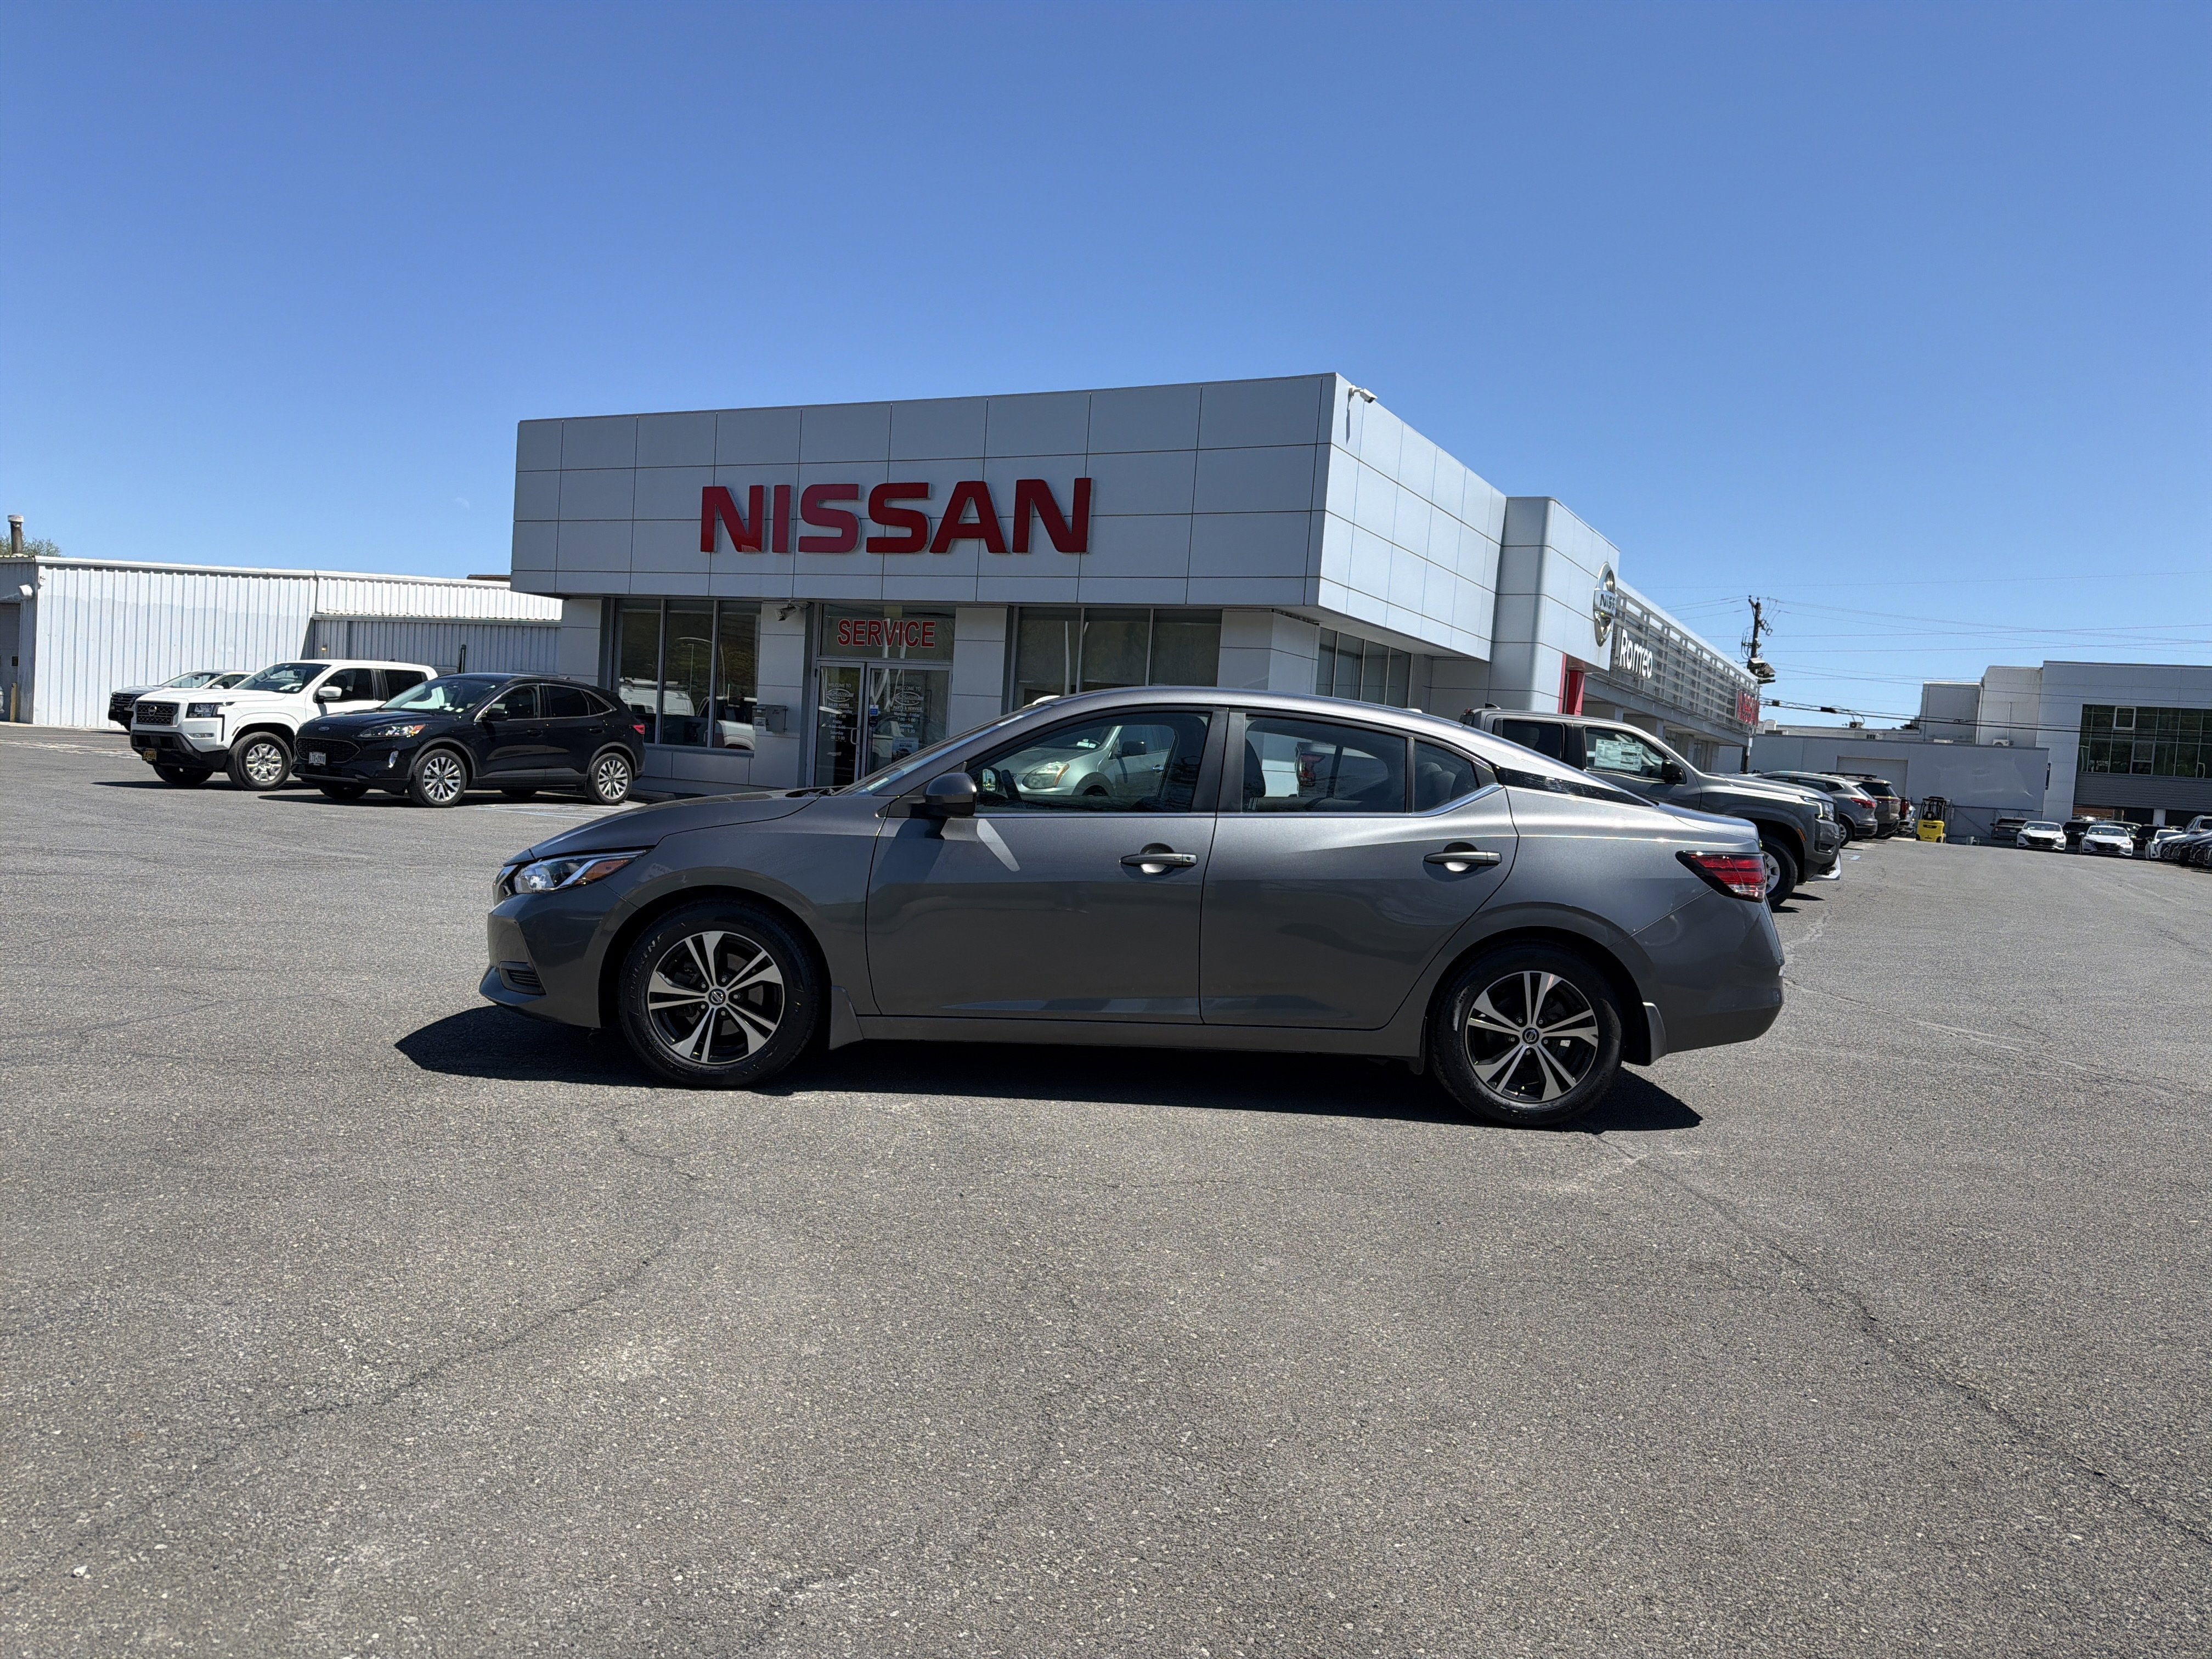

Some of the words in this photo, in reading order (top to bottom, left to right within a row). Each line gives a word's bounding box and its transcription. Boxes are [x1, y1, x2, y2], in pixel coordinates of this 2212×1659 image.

[700, 477, 1093, 554] NISSAN
[837, 618, 936, 649] SERVICE
[1618, 629, 1653, 679] Romeo
